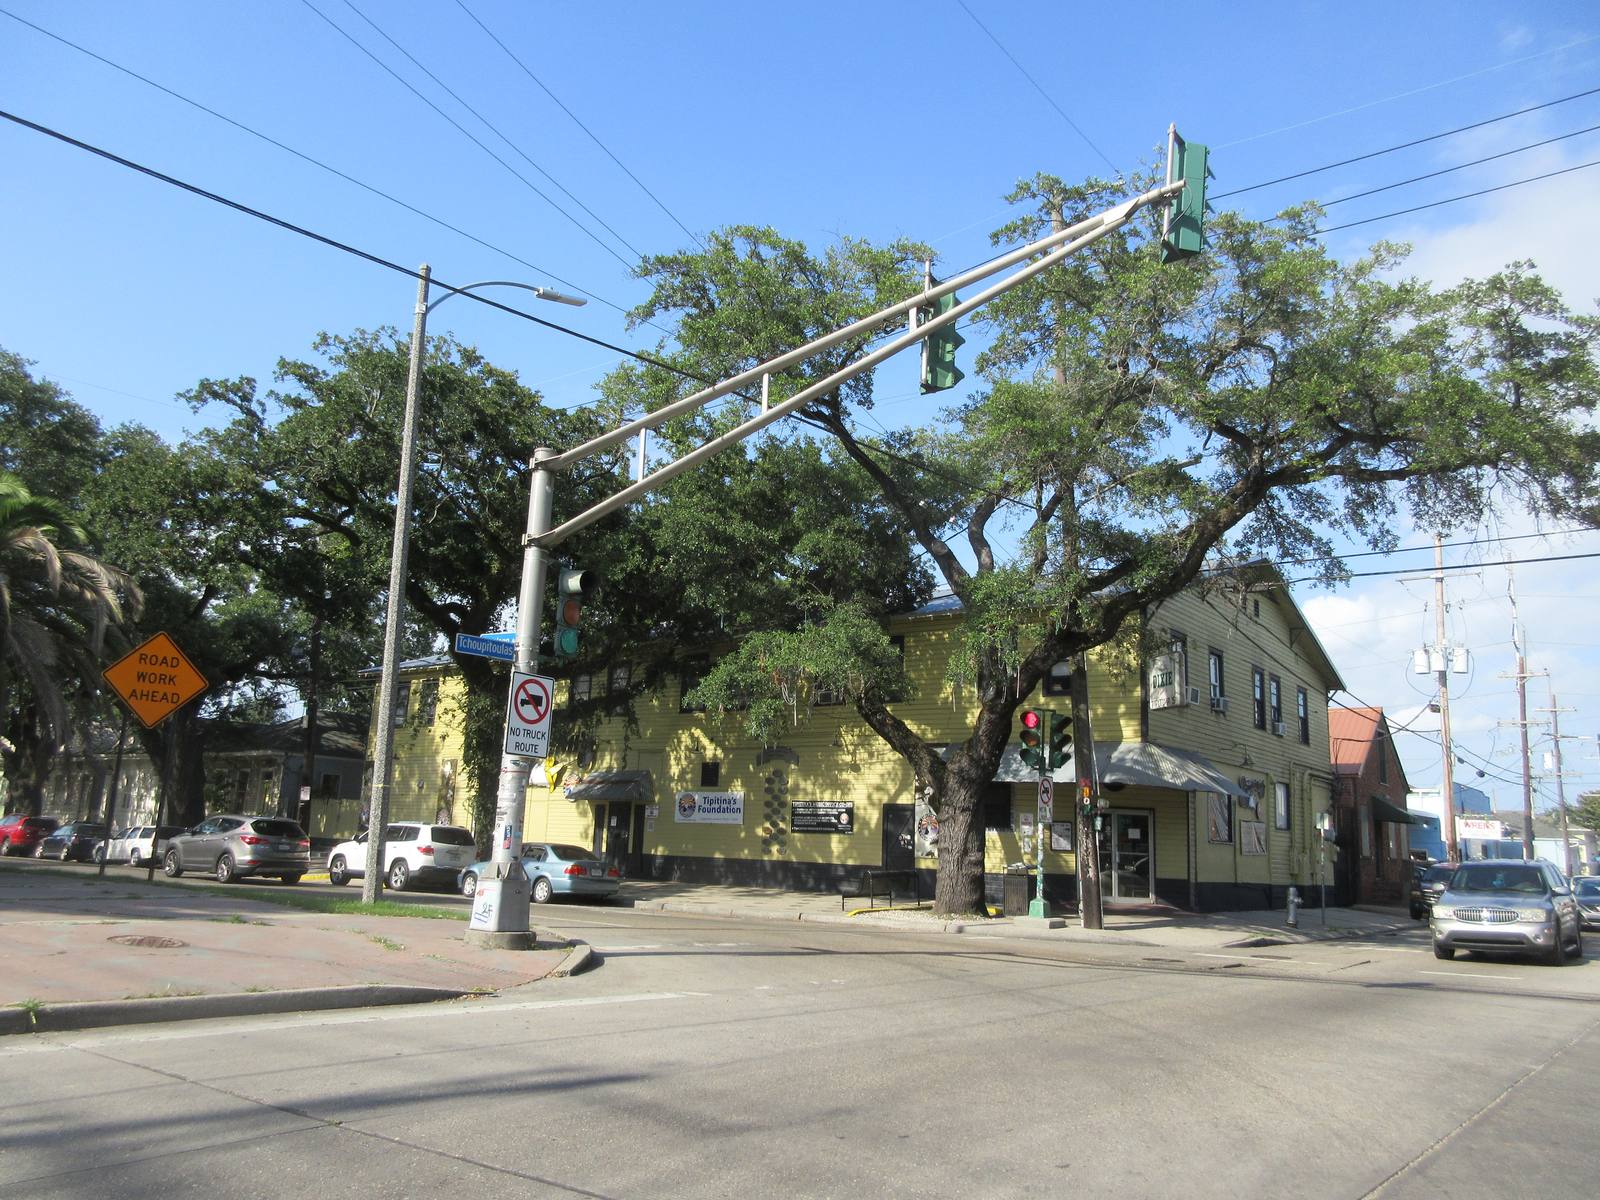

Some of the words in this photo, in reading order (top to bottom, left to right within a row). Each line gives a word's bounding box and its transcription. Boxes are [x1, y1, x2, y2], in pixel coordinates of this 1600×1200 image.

[459, 635, 513, 656] Tchoupitoulas
[138, 653, 181, 669] ROAD
[136, 671, 177, 686] WORK
[1152, 672, 1173, 689] DIXIE
[128, 688, 181, 705] AHEAD
[509, 726, 521, 737] NO
[522, 728, 547, 741] TRUCK
[514, 741, 539, 754] ROUTE
[702, 796, 737, 806] Tipitina's
[697, 804, 741, 814] Foundation
